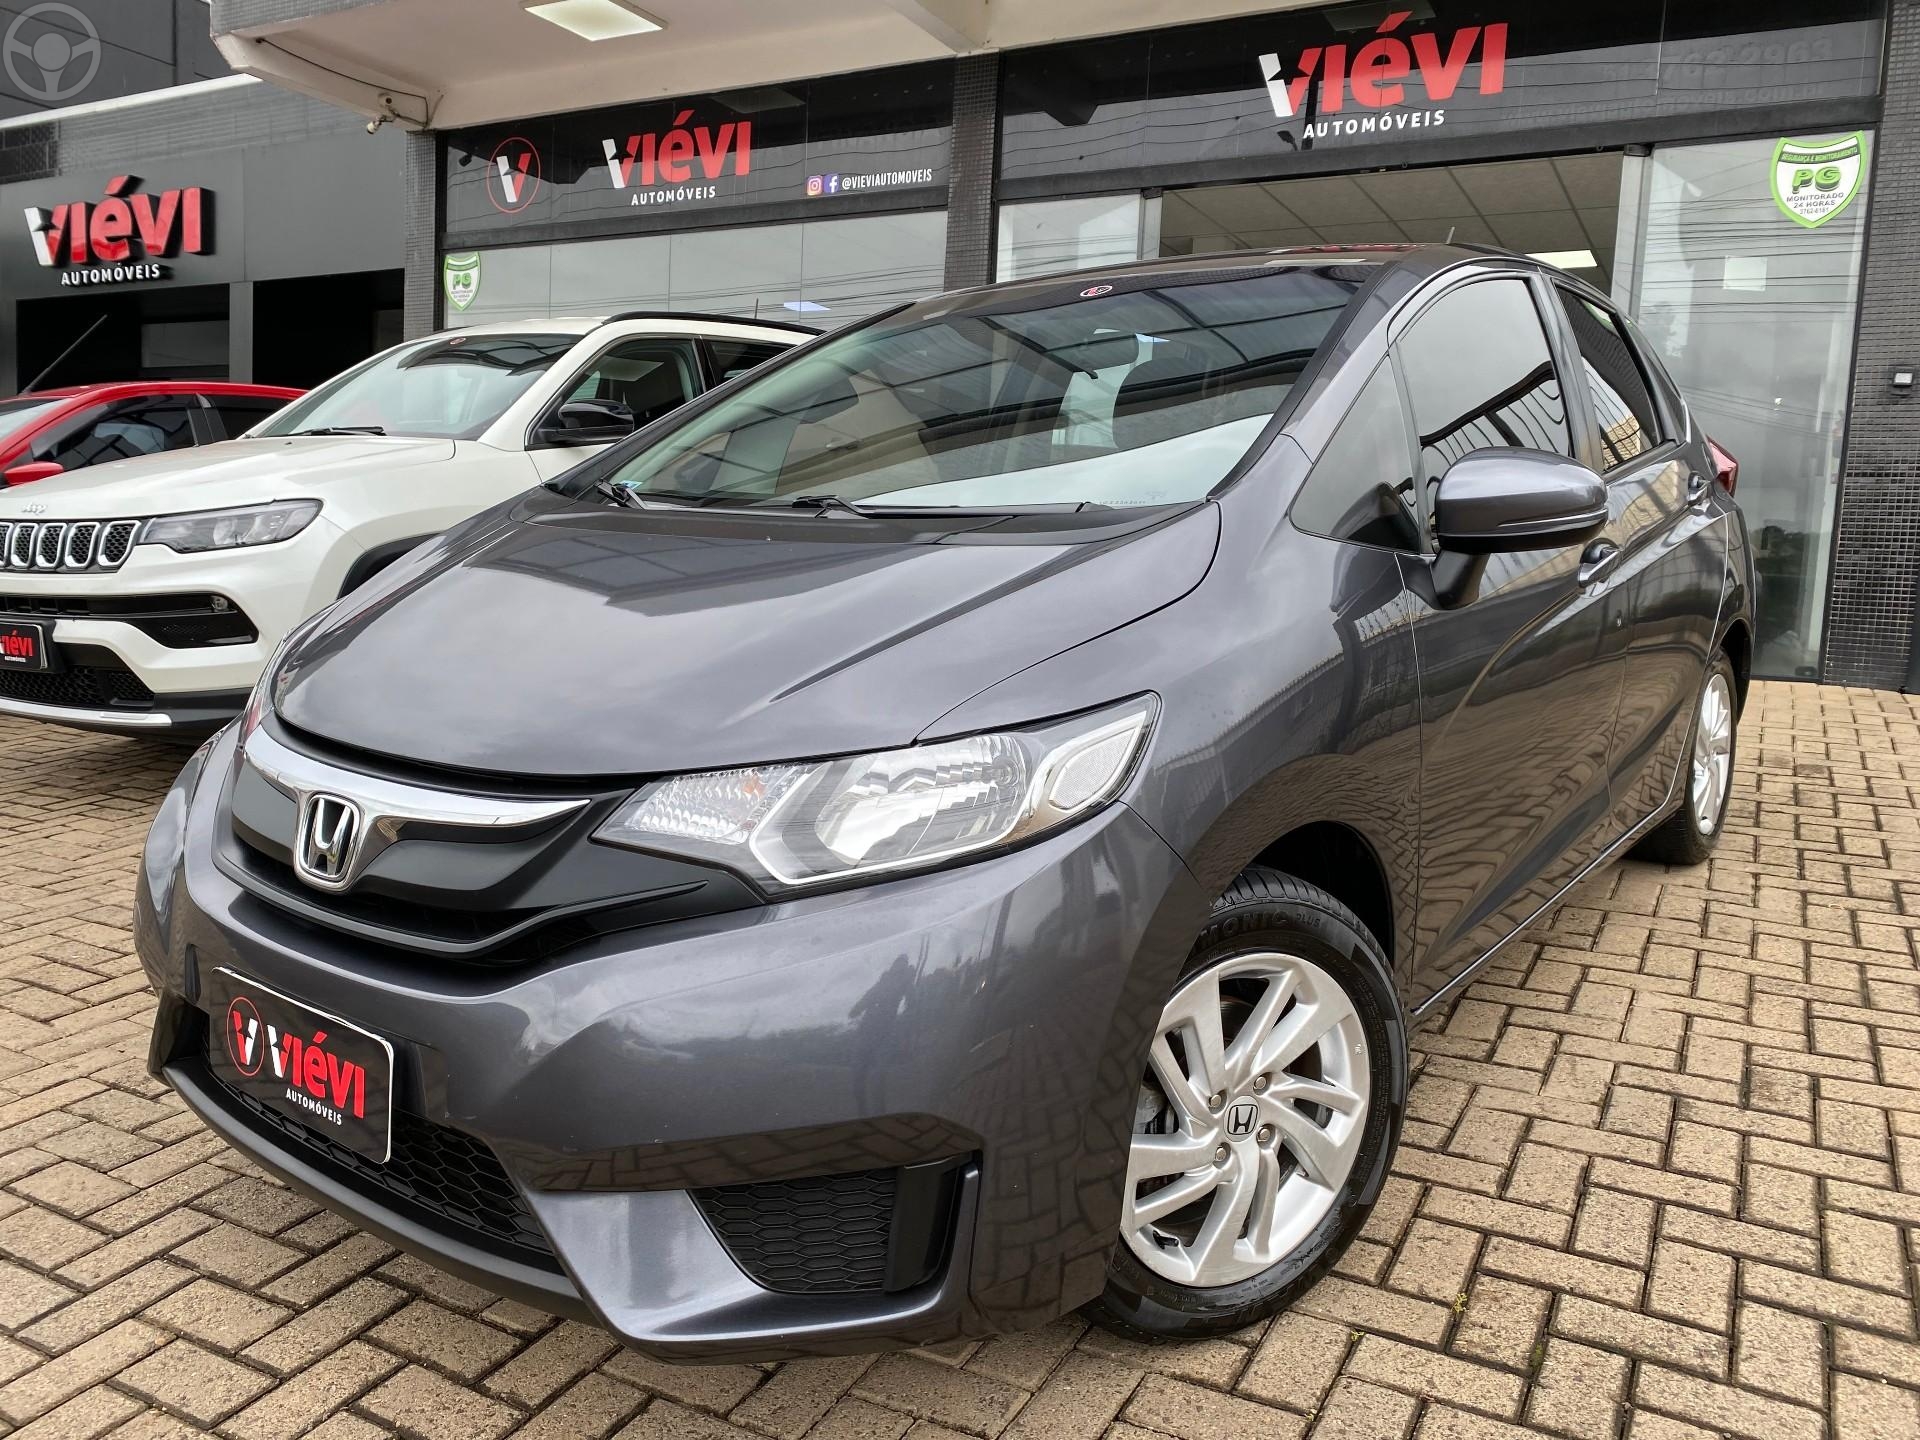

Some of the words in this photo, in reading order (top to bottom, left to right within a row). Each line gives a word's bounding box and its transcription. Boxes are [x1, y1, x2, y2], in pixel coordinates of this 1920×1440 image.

[1302, 109, 1446, 139] AUTOMÓVEIS
[841, 168, 932, 190] @VIEVIAUTOMOVEIS
[1792, 166, 1841, 194] PG
[631, 185, 717, 206] AUTOMÓVEIS
[1786, 192, 1844, 202] MONITORADO
[1806, 200, 1836, 208] HORAS
[61, 262, 162, 286] AUTOMÓVEIS
[285, 1087, 343, 1126] AUTOMÓVEIS
